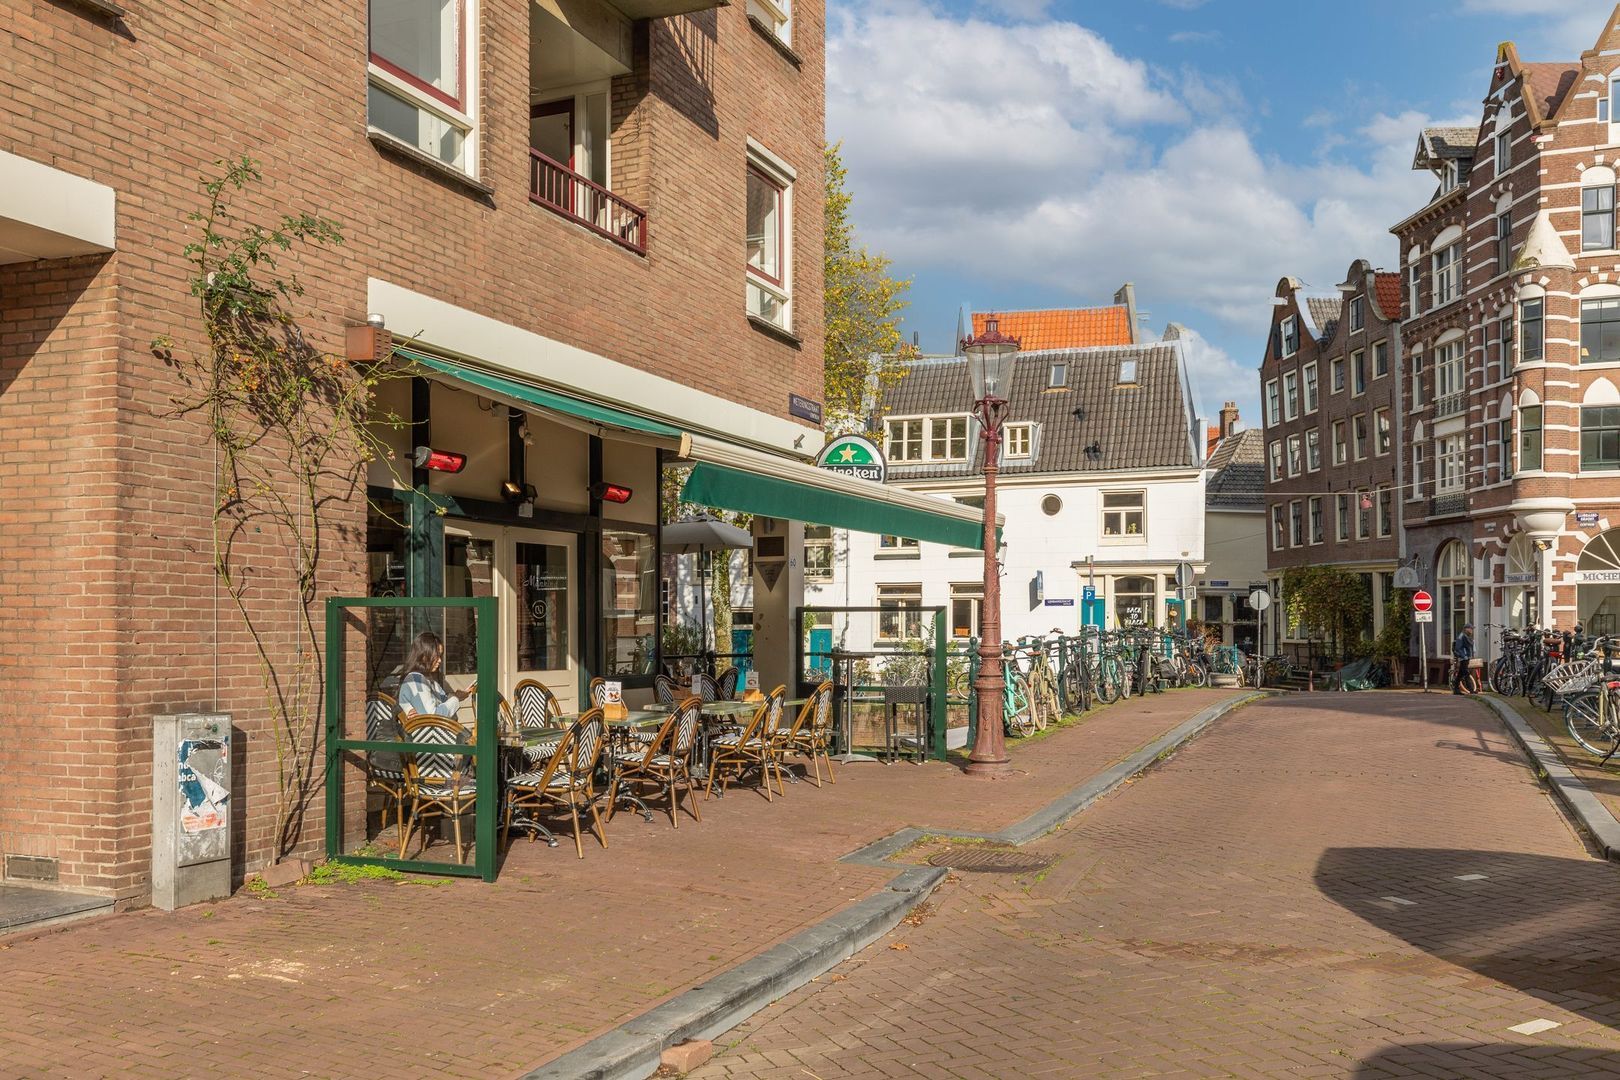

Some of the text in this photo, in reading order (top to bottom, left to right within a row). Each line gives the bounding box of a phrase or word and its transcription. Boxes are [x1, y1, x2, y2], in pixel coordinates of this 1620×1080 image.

[821, 466, 878, 478] ineken
[1583, 572, 1620, 581] MICHE
[1086, 591, 1092, 600] P
